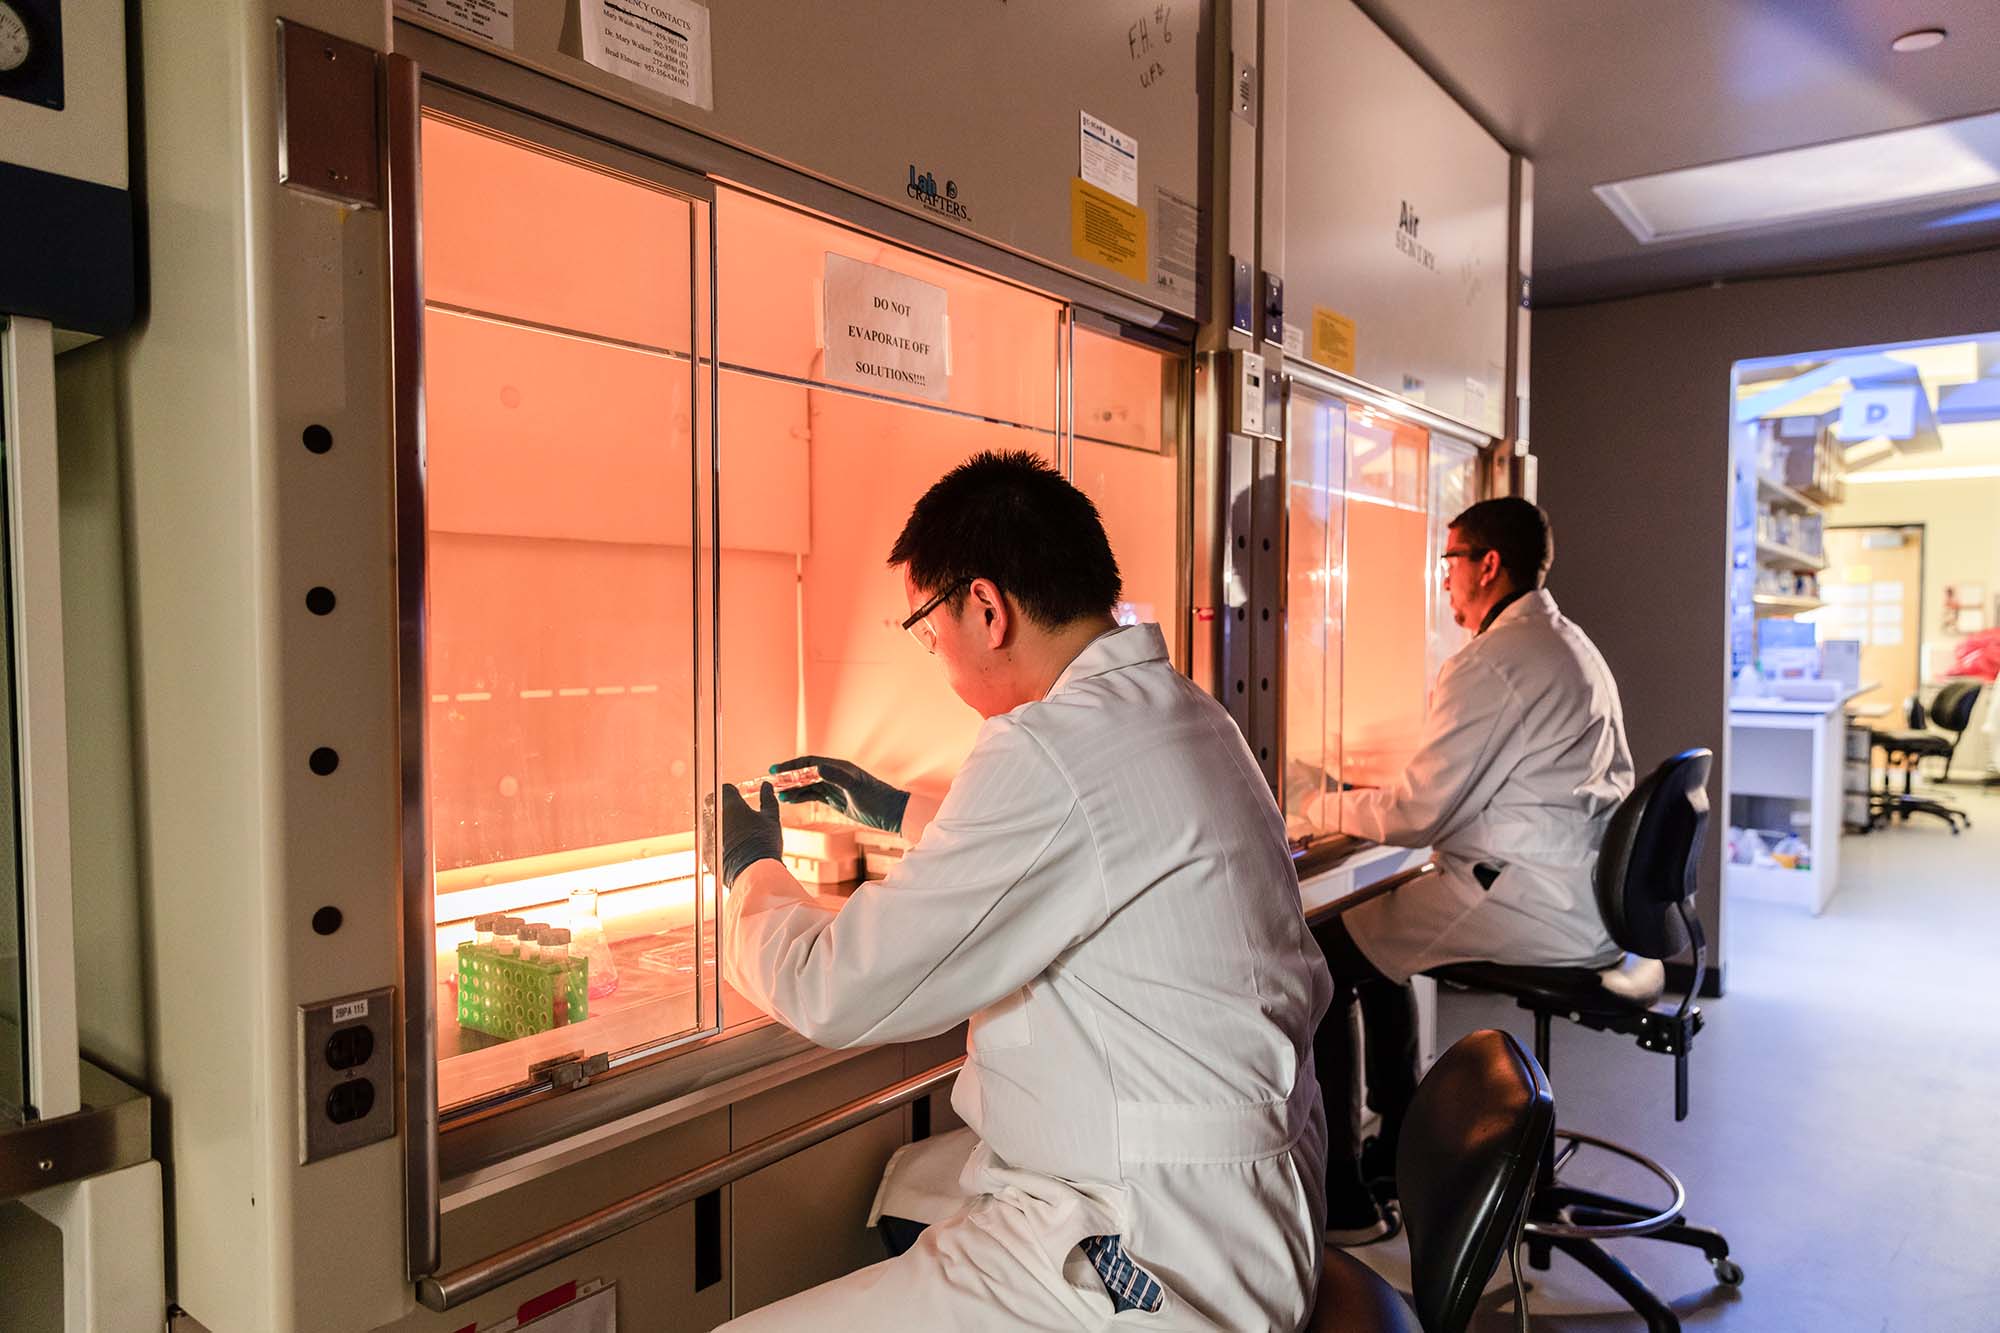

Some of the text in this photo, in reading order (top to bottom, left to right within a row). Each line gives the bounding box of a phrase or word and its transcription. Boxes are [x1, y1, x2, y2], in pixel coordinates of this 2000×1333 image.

[651, 7, 691, 30] CONTACTS
[605, 28, 615, 39] Dr.
[616, 33, 630, 45] Mary
[907, 184, 967, 220] CRAFTERS
[1399, 200, 1419, 238] Air
[873, 296, 911, 318] DO NOT
[848, 325, 930, 356] EVAPORATE OFF
[1865, 404, 1888, 424] D
